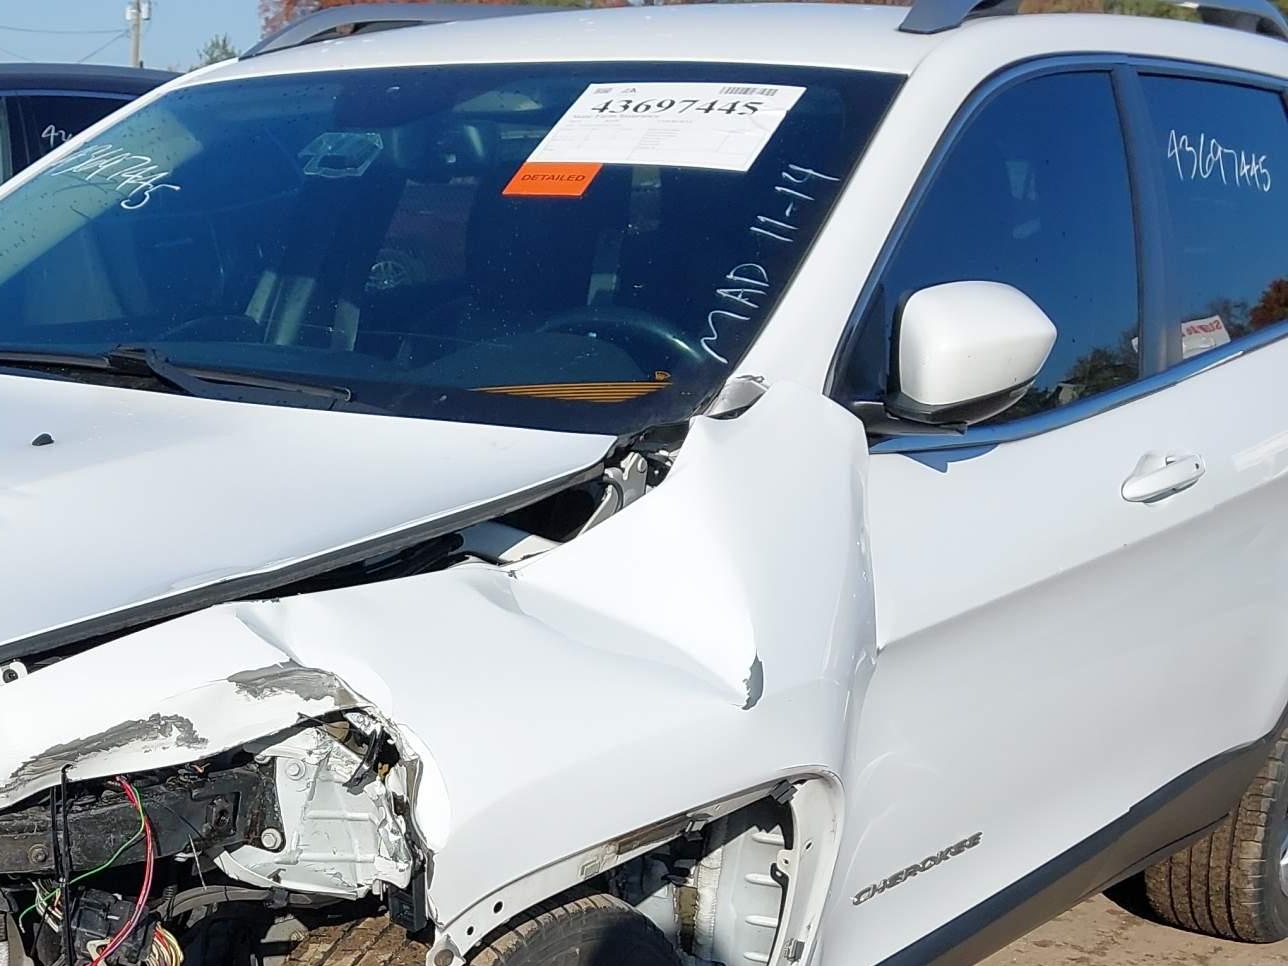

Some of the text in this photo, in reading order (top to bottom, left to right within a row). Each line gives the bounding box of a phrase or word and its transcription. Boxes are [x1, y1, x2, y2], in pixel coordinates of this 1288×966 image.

[592, 99, 764, 115] 43697445
[521, 174, 586, 182] DETAILED
[1167, 129, 1271, 192] 43697445
[700, 263, 770, 364] MAD
[851, 831, 983, 906] CHEROKEE
